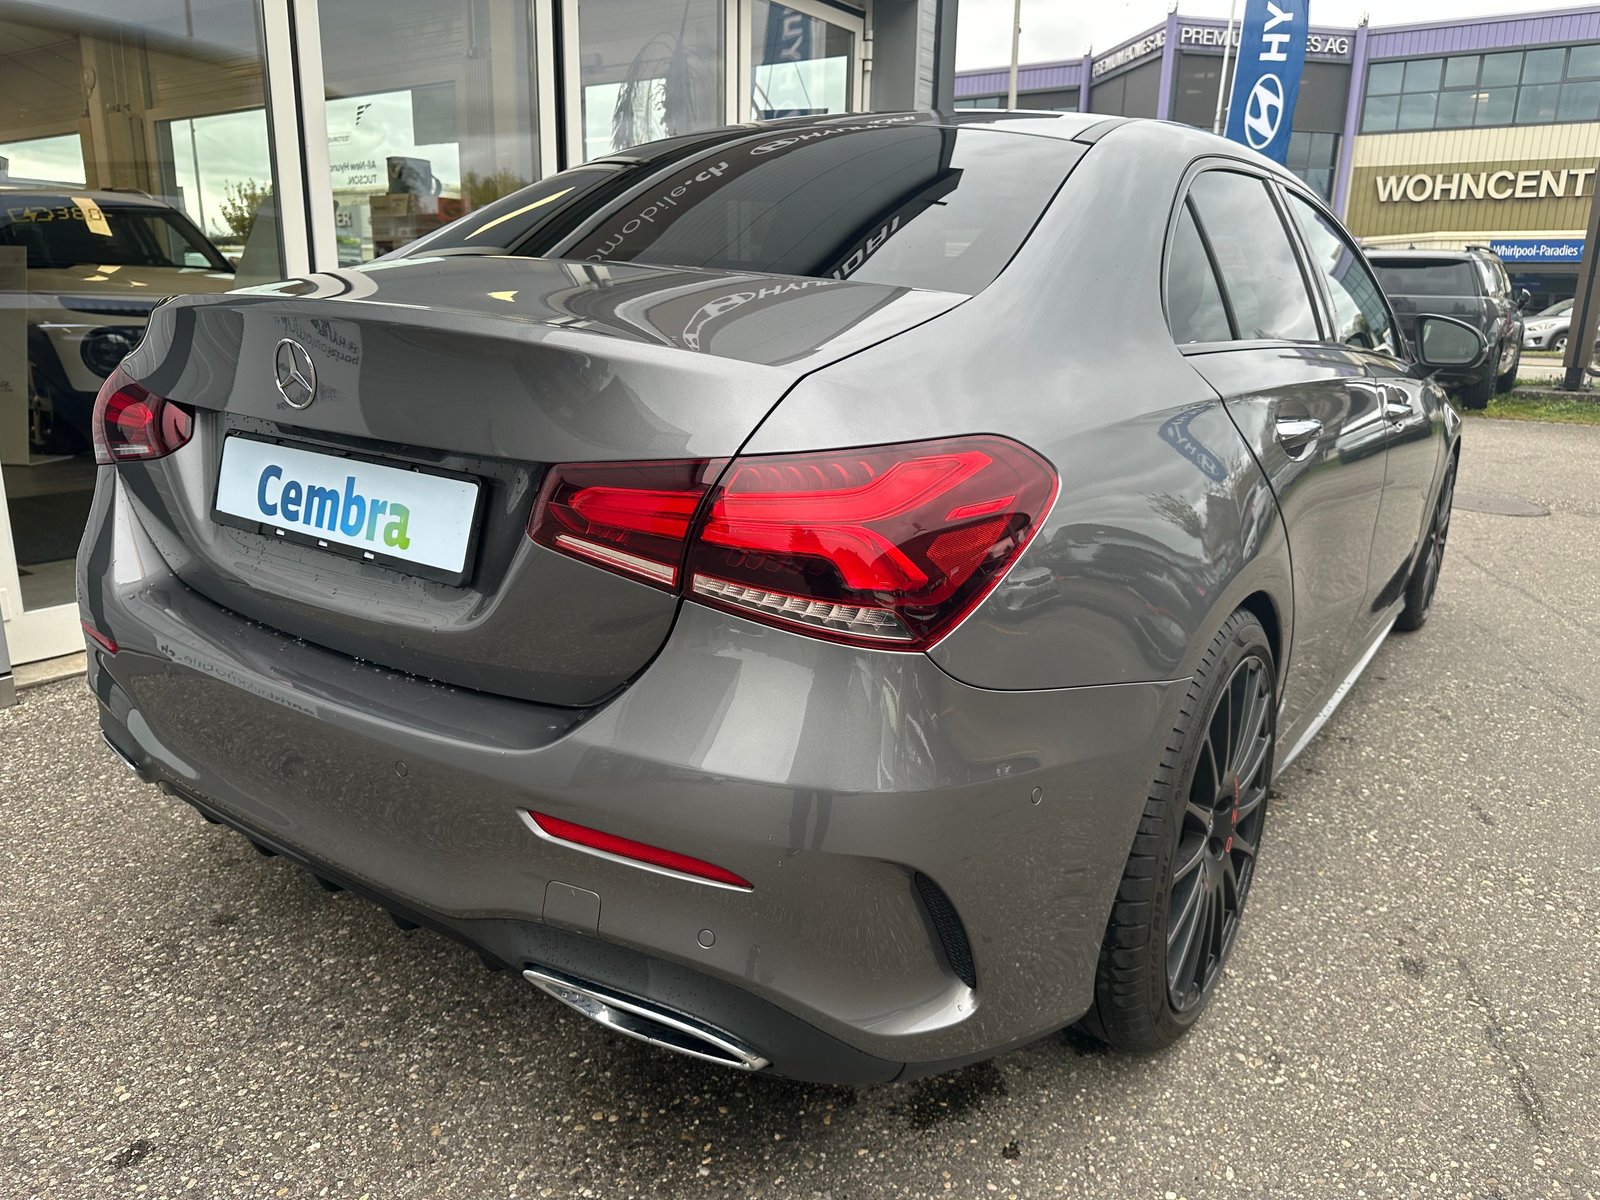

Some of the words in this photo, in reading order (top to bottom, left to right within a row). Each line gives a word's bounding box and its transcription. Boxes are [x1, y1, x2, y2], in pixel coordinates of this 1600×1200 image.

[1259, 1, 1293, 62] HY
[1324, 38, 1349, 55] AG
[1375, 168, 1596, 203] WOHNCENT
[1493, 244, 1578, 259] Whirlpool-Paradies
[257, 464, 411, 550] Cembra
